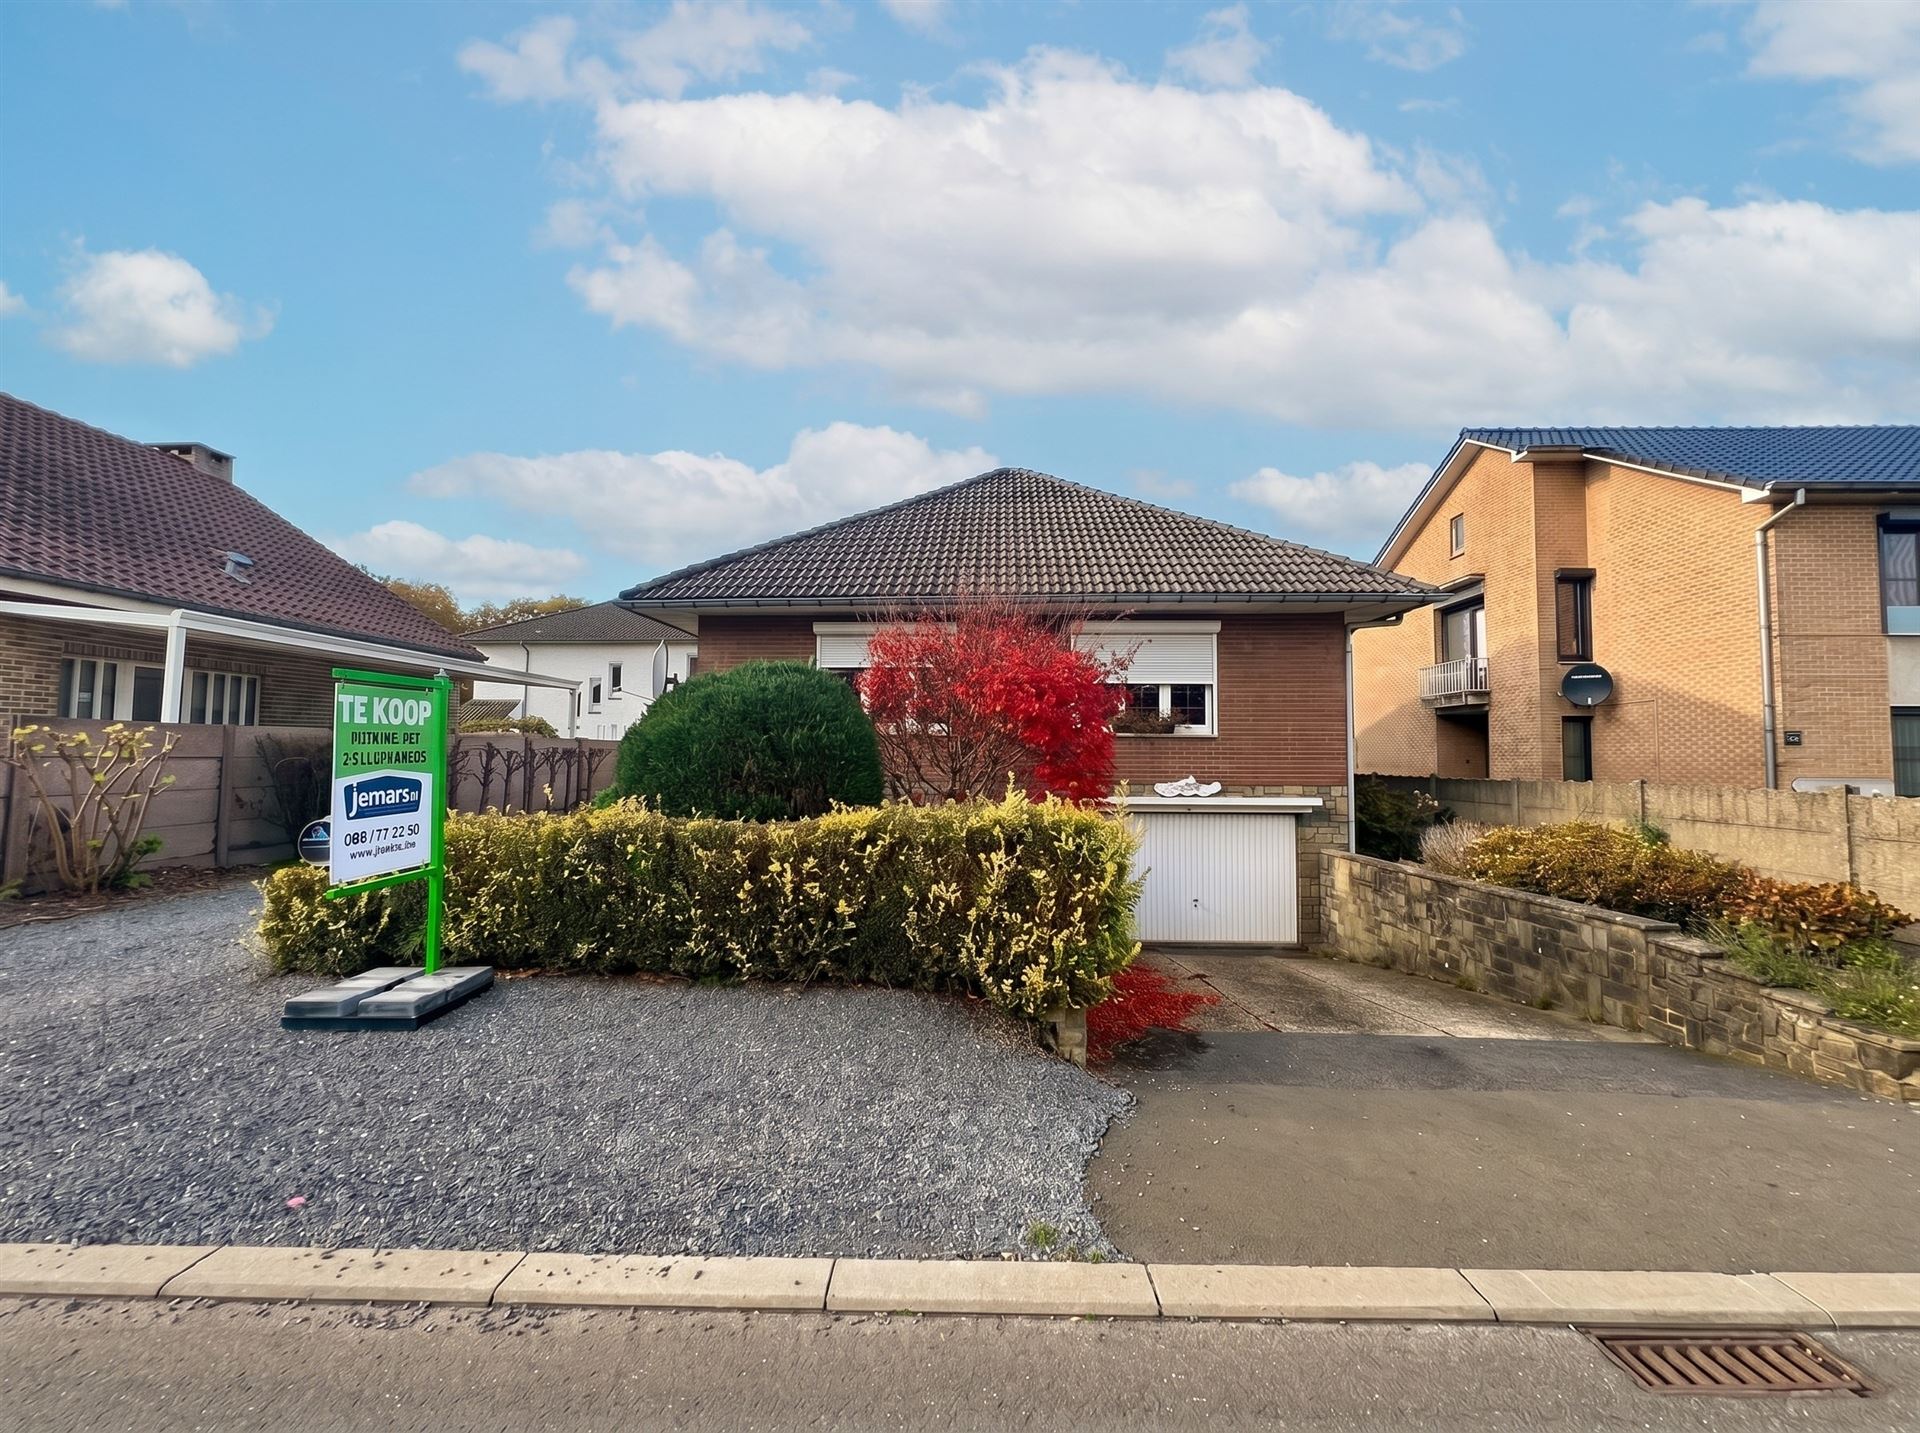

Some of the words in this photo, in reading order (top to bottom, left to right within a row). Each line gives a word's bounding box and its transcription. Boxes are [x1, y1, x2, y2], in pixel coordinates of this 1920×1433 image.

[339, 694, 367, 724] TE
[373, 697, 432, 726] KOOP
[403, 732, 421, 745] PET
[391, 825, 405, 839] 22
[407, 823, 420, 836] 50
